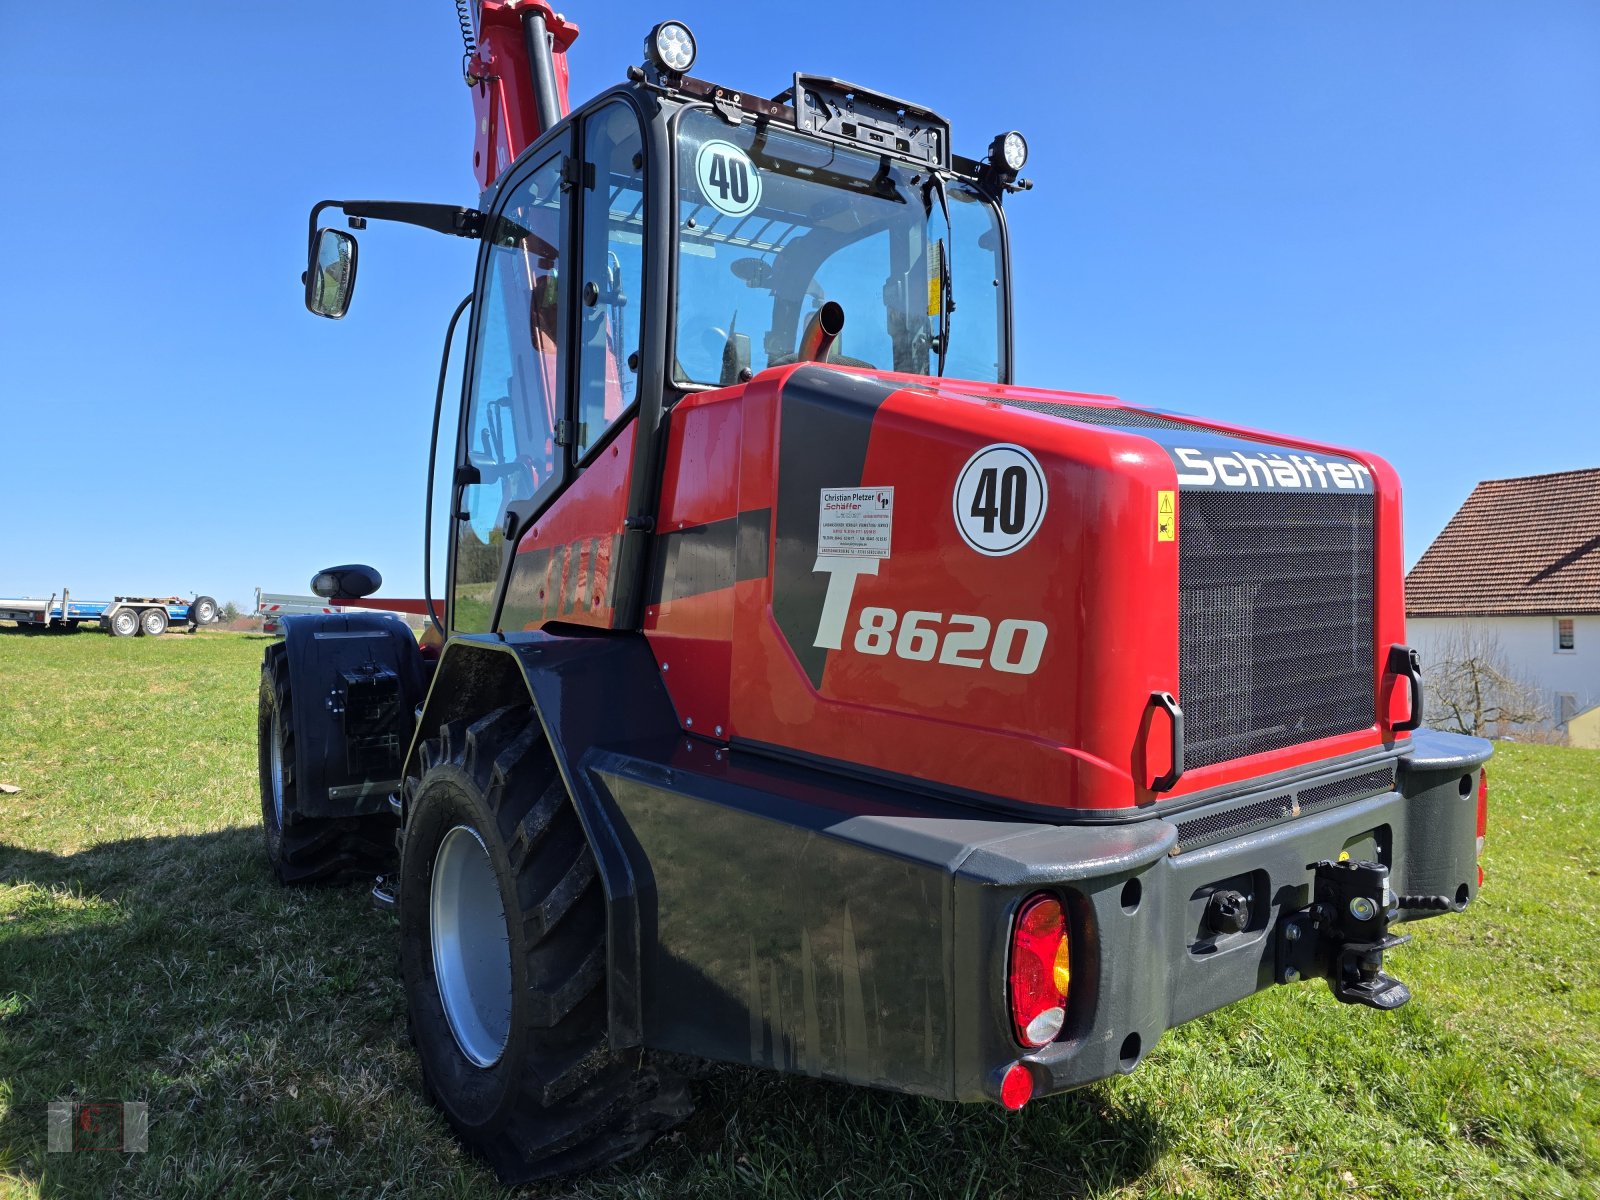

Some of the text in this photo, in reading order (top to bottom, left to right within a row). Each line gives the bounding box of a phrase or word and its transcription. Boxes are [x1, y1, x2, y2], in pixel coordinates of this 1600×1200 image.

[709, 153, 749, 204] 40
[1174, 447, 1371, 489] Schäffer
[824, 493, 875, 502] Christian Pletzer
[970, 465, 1027, 535] 40
